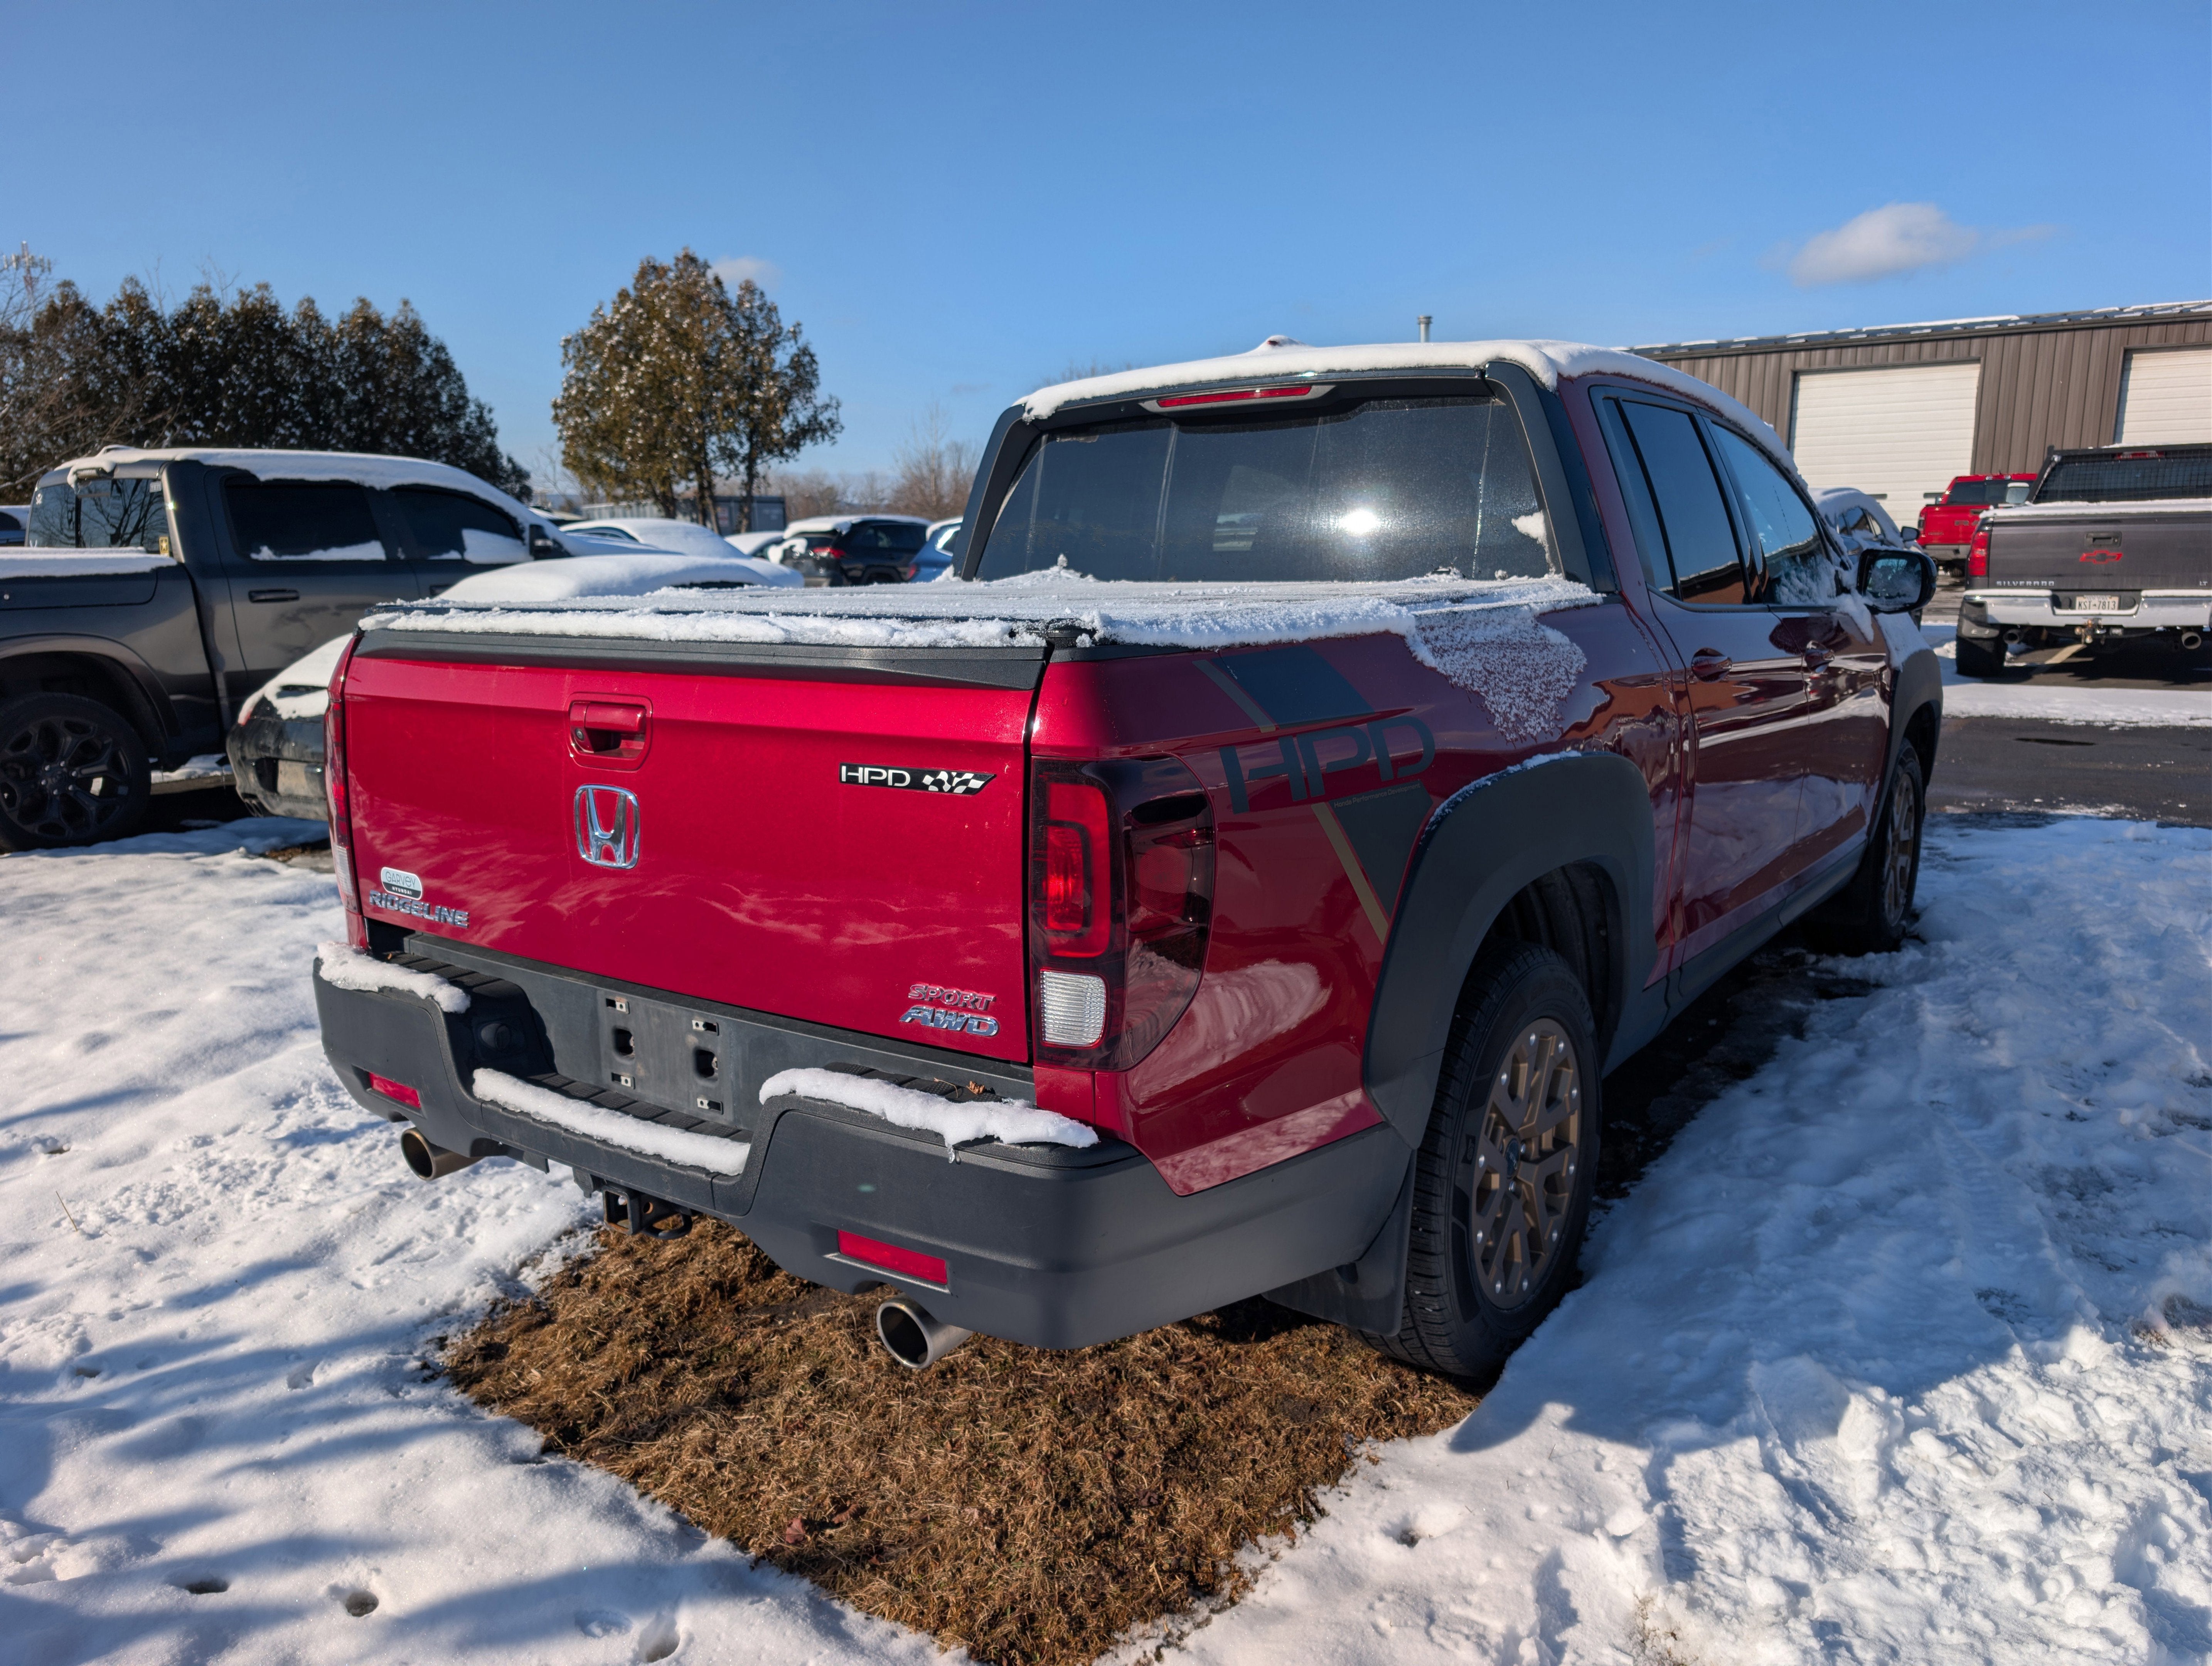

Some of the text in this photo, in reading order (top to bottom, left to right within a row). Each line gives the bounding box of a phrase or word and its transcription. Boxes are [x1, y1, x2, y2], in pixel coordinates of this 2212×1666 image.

[841, 766, 911, 787] HPD
[1219, 716, 1435, 815] HPD
[1334, 783, 1421, 808] Honda Performance Development
[392, 885, 412, 895] HYUNDAI
[369, 889, 469, 929] RIDGELINE
[908, 984, 996, 1011] SPORT
[899, 1005, 999, 1036] AWD
